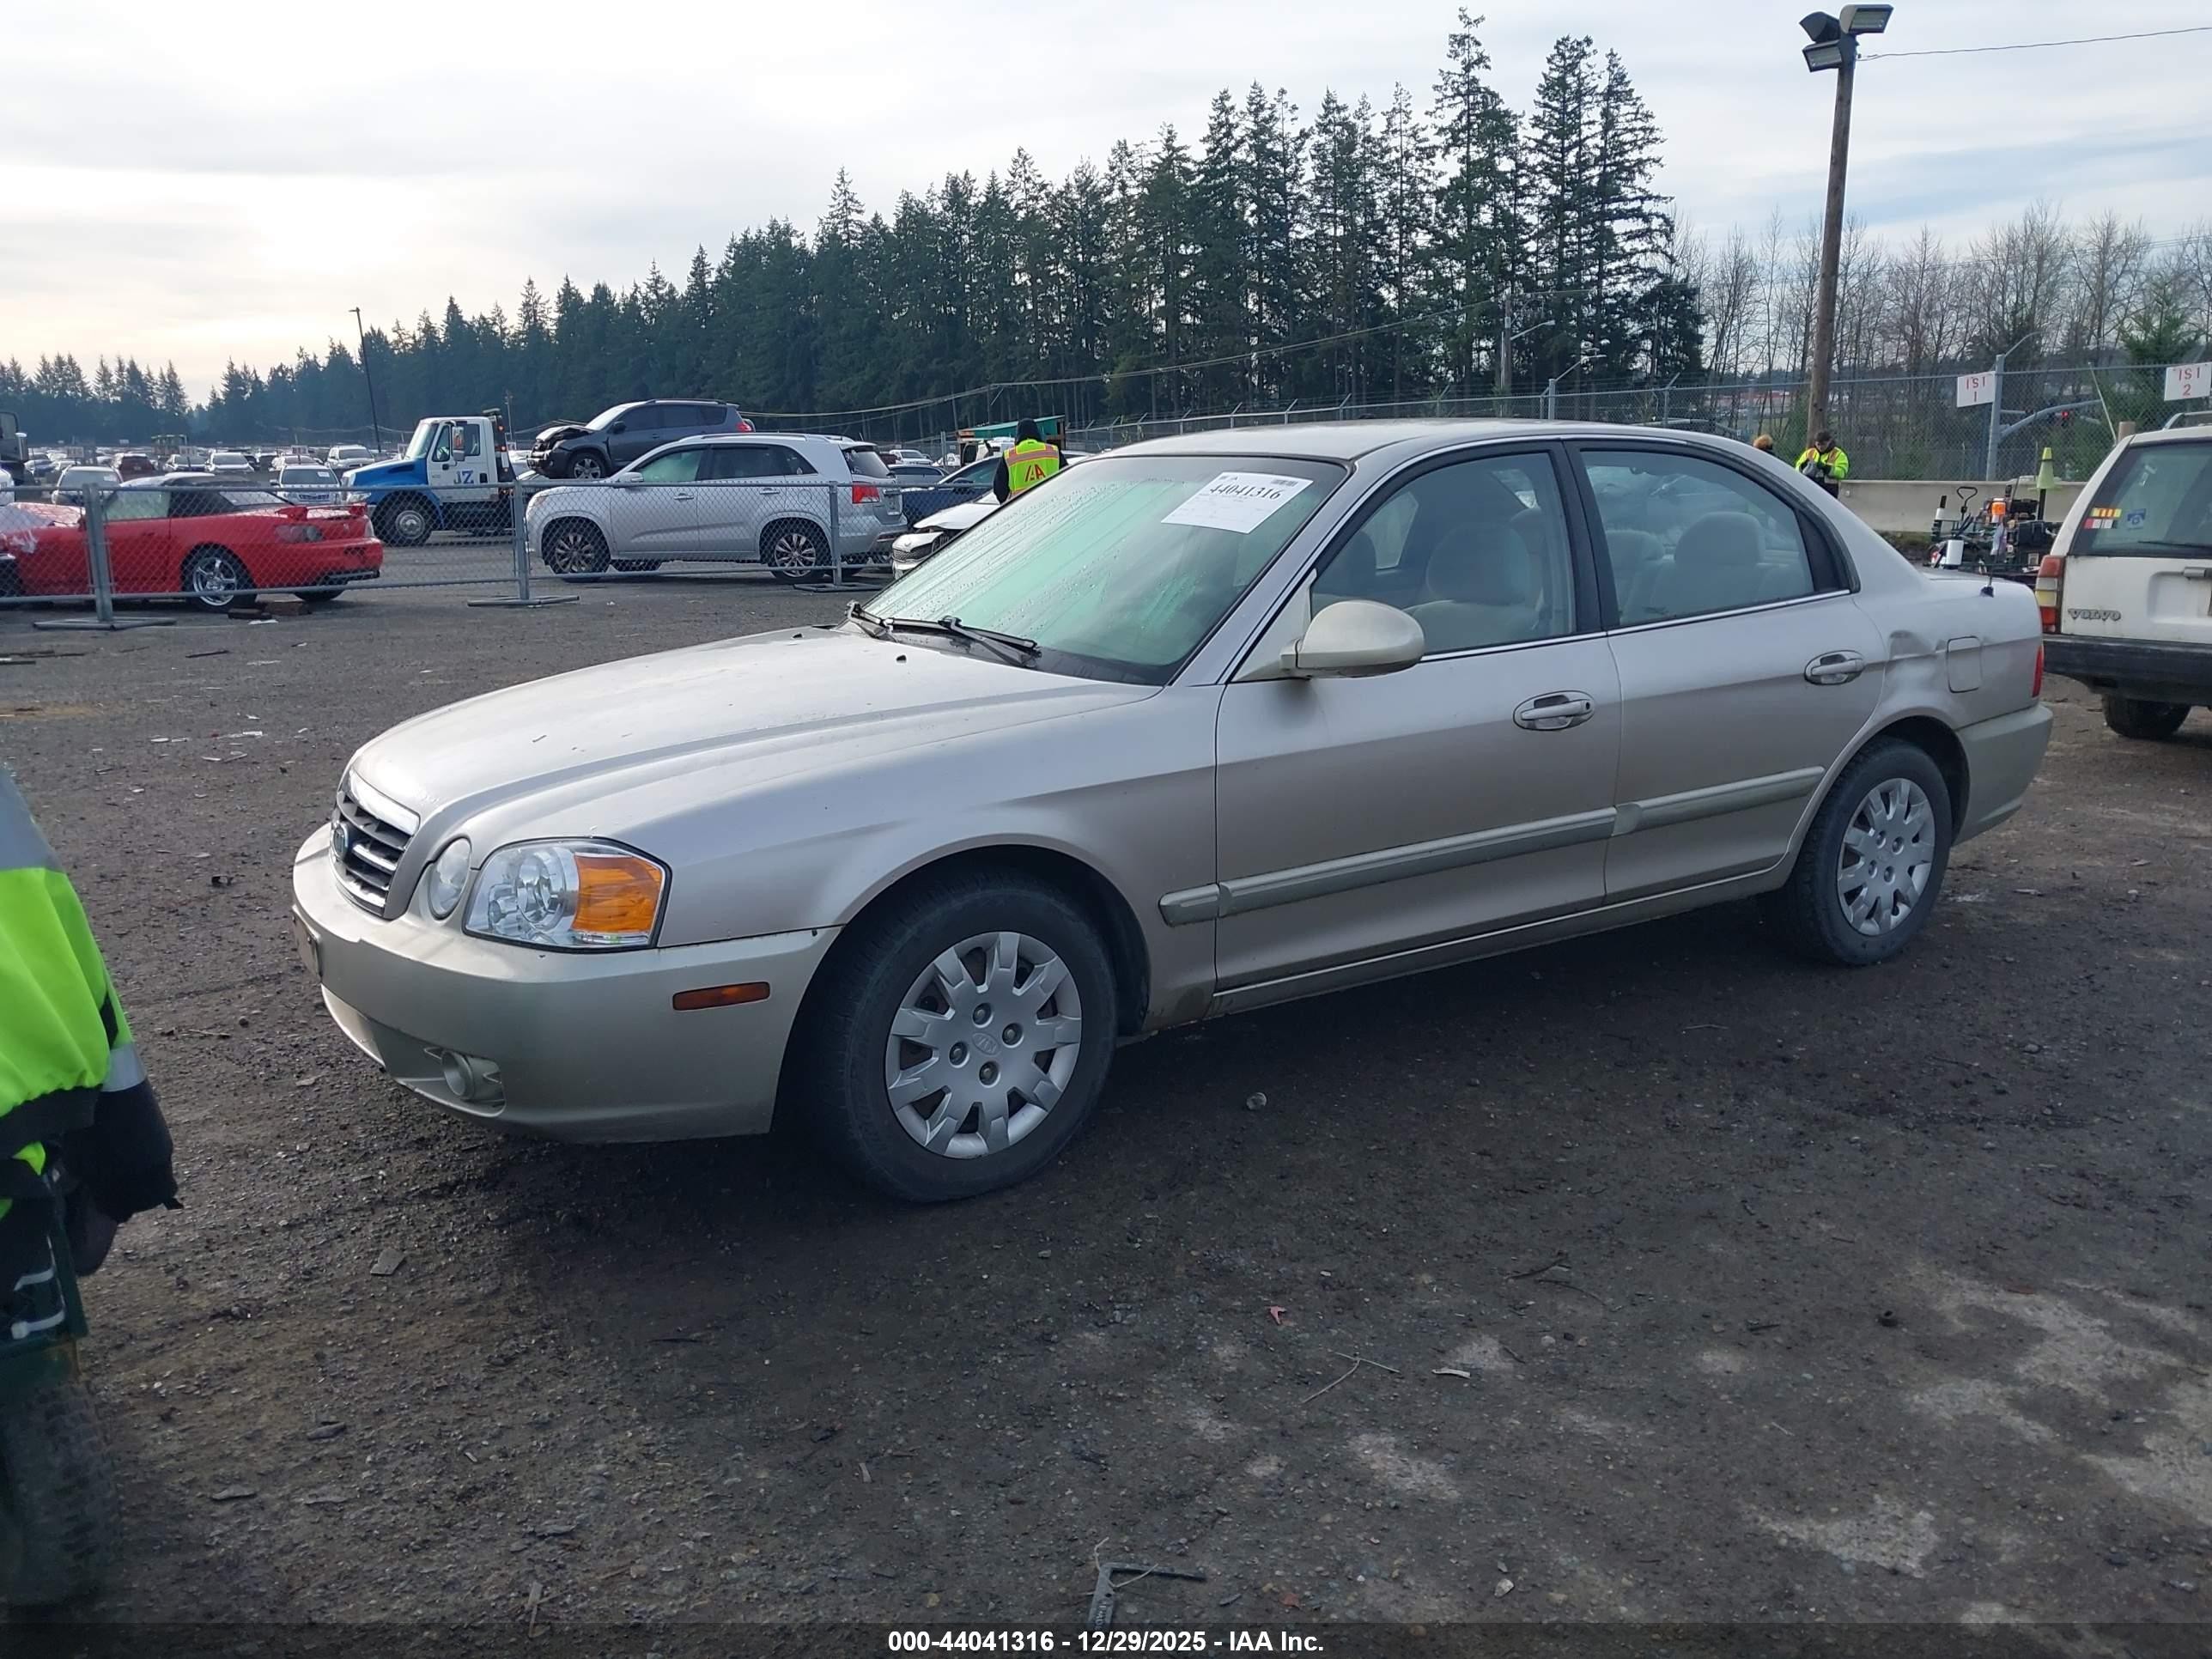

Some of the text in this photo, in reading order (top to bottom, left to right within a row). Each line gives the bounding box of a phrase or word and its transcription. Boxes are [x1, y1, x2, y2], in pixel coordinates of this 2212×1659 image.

[2183, 384, 2191, 396] 2
[1209, 483, 1285, 500] 44041316
[2067, 608, 2122, 622] VOLVO
